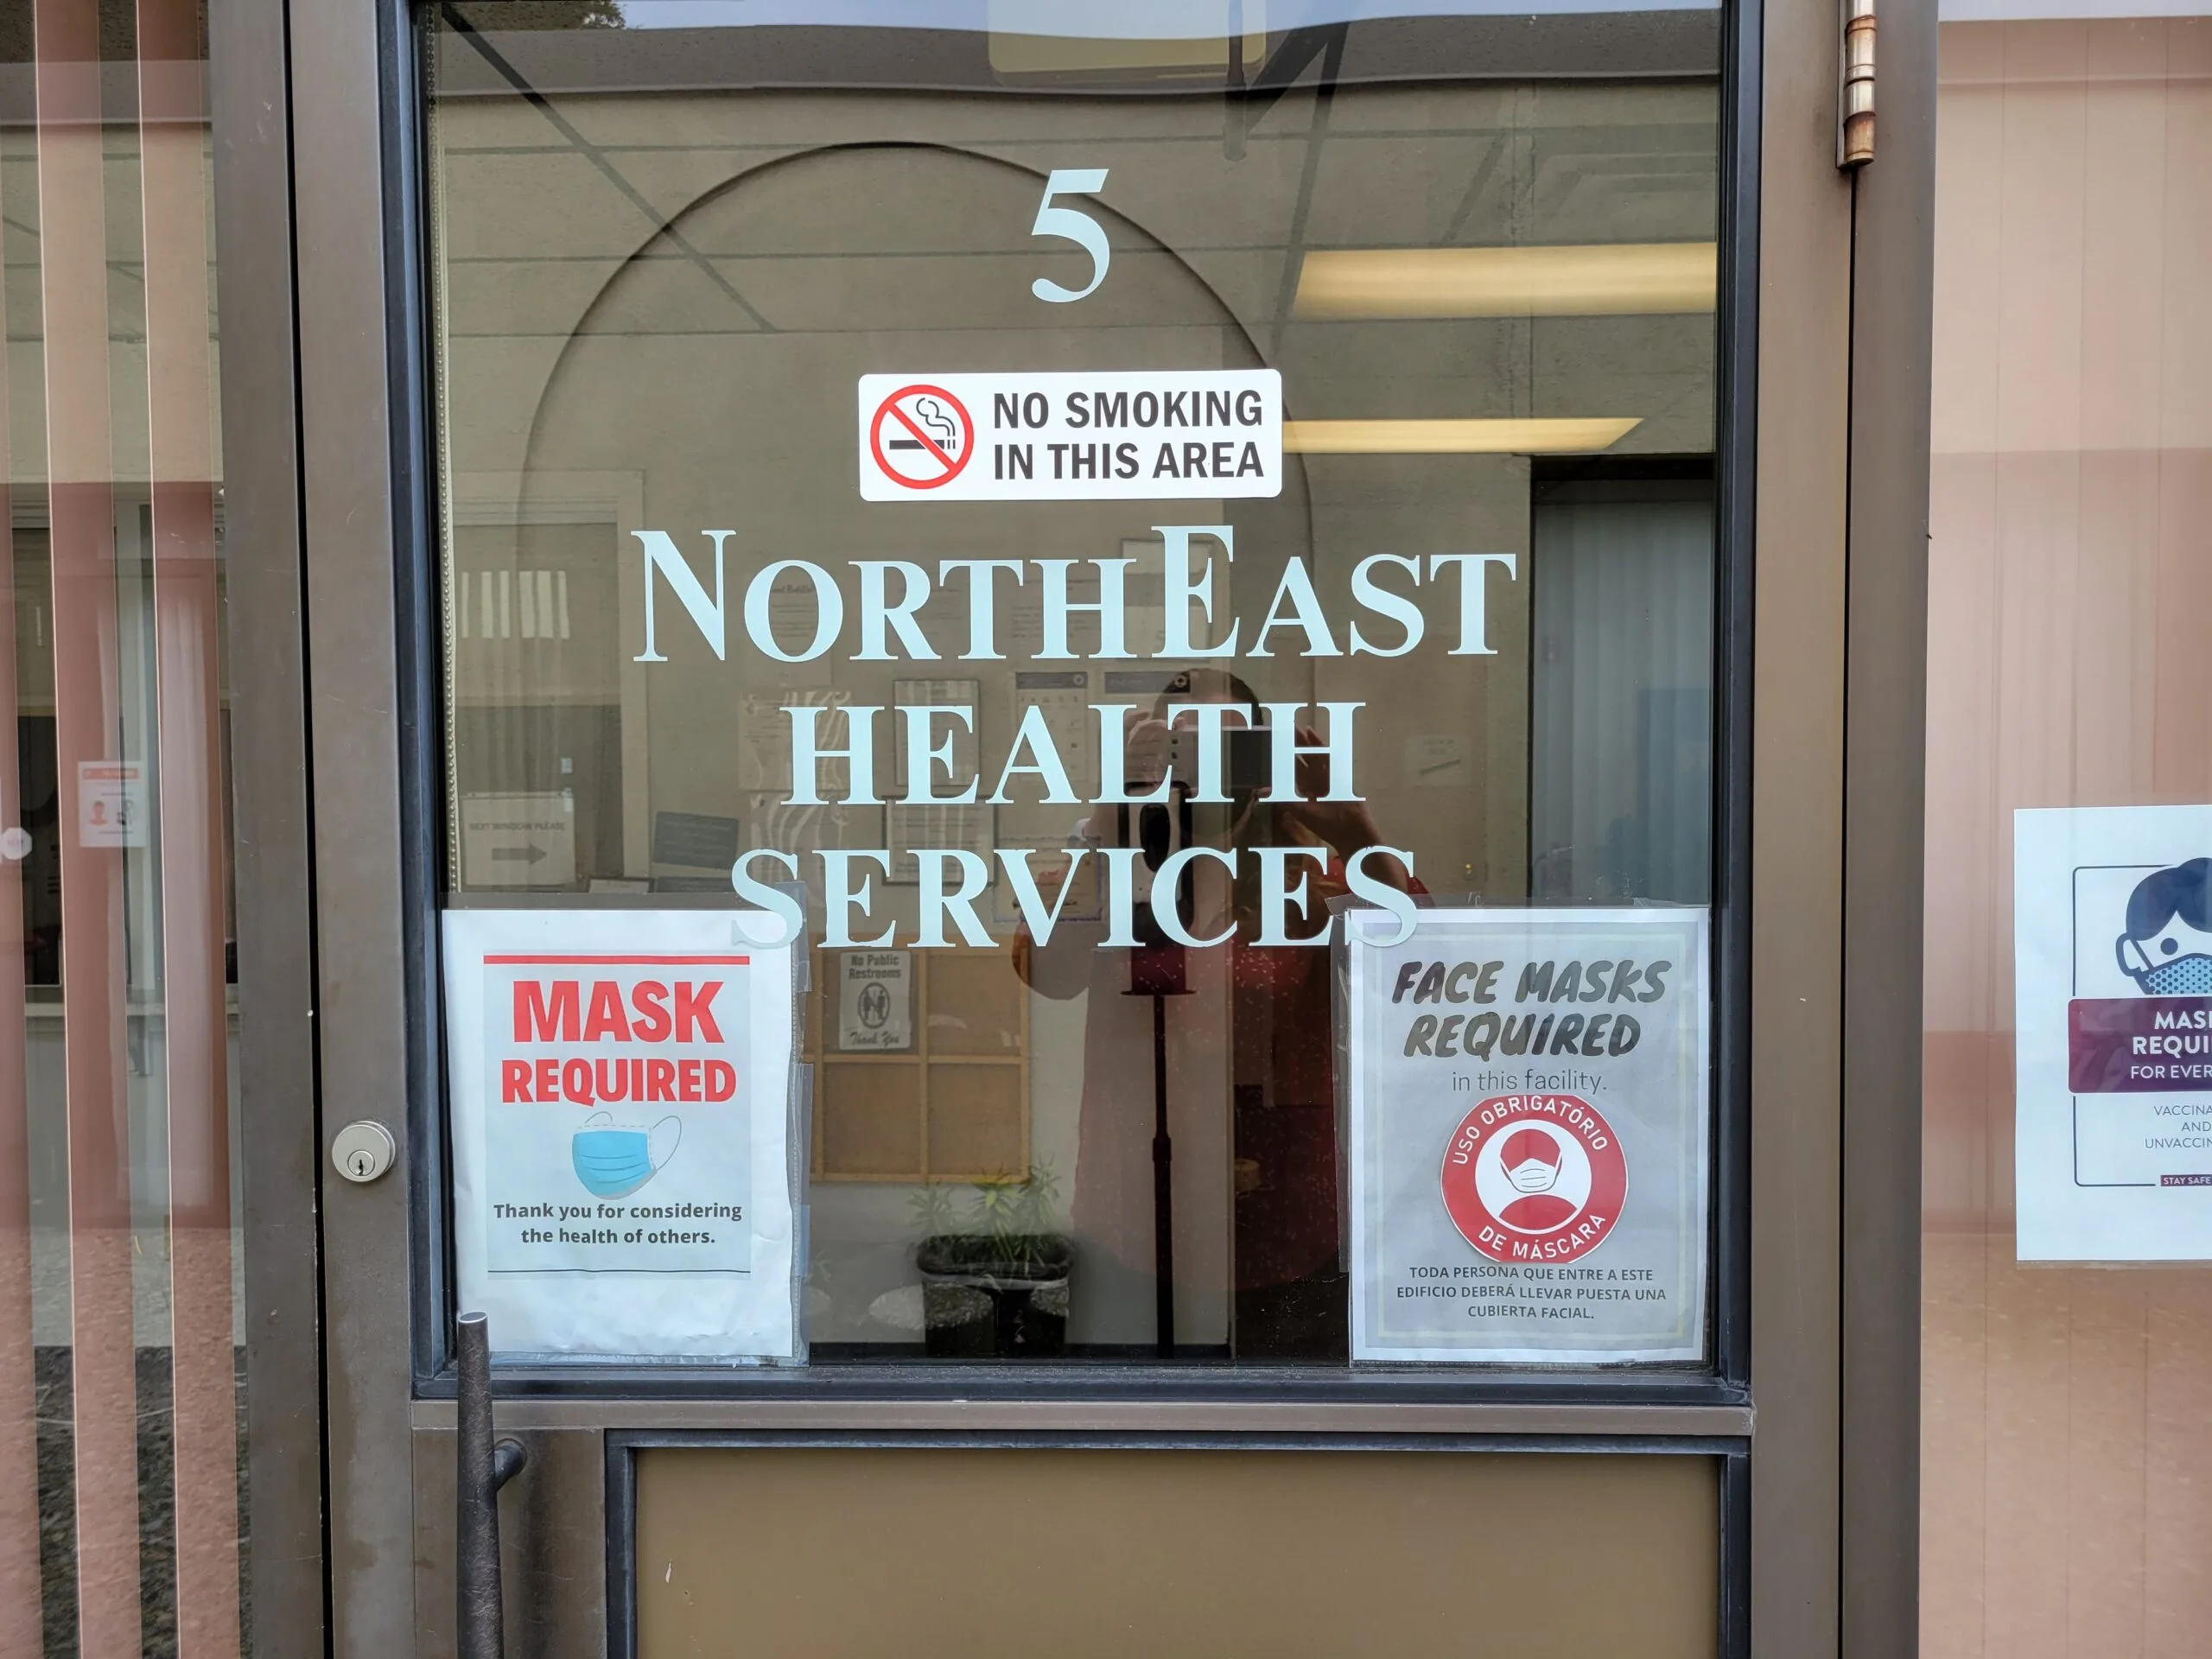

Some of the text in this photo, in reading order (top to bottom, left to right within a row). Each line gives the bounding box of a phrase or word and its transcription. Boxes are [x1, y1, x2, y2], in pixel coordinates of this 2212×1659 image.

[1031, 168, 1110, 303] 5
[994, 389, 1263, 429] NO SMOKING
[995, 441, 1264, 480] IN THIS AREA
[779, 702, 1366, 805] HEALTH
[731, 844, 1418, 949] SERVICES
[851, 953, 899, 966] No Public
[849, 968, 901, 979] Restrooms
[1391, 959, 1672, 1004] FACE MASKS
[512, 980, 725, 1044] MASK
[2154, 1010, 2212, 1029] MAS
[1403, 1012, 1642, 1062] REQUIRED
[2133, 1035, 2212, 1058] REQUI
[502, 1058, 737, 1108] REQUIRED
[1452, 1069, 1607, 1095] in this facility.
[2131, 1065, 2165, 1079] FOR
[1452, 1095, 1608, 1165] USO OBRIGATÓRIO
[2181, 1121, 2212, 1132] AND
[2163, 1176, 2212, 1185] STAY SAFE
[493, 1203, 742, 1222] Thank you for considering
[521, 1228, 715, 1244] the health of others.
[1478, 1214, 1606, 1259] DE MÁSCARA
[1409, 1266, 1653, 1281] TODA PERSONA QUE ENTRE A ESTE
[1397, 1283, 1667, 1300] EDIFICIO DEBERÁ LLEVAR PUESTA UNA
[1468, 1305, 1594, 1319] CUBIERTA FACIAL.
